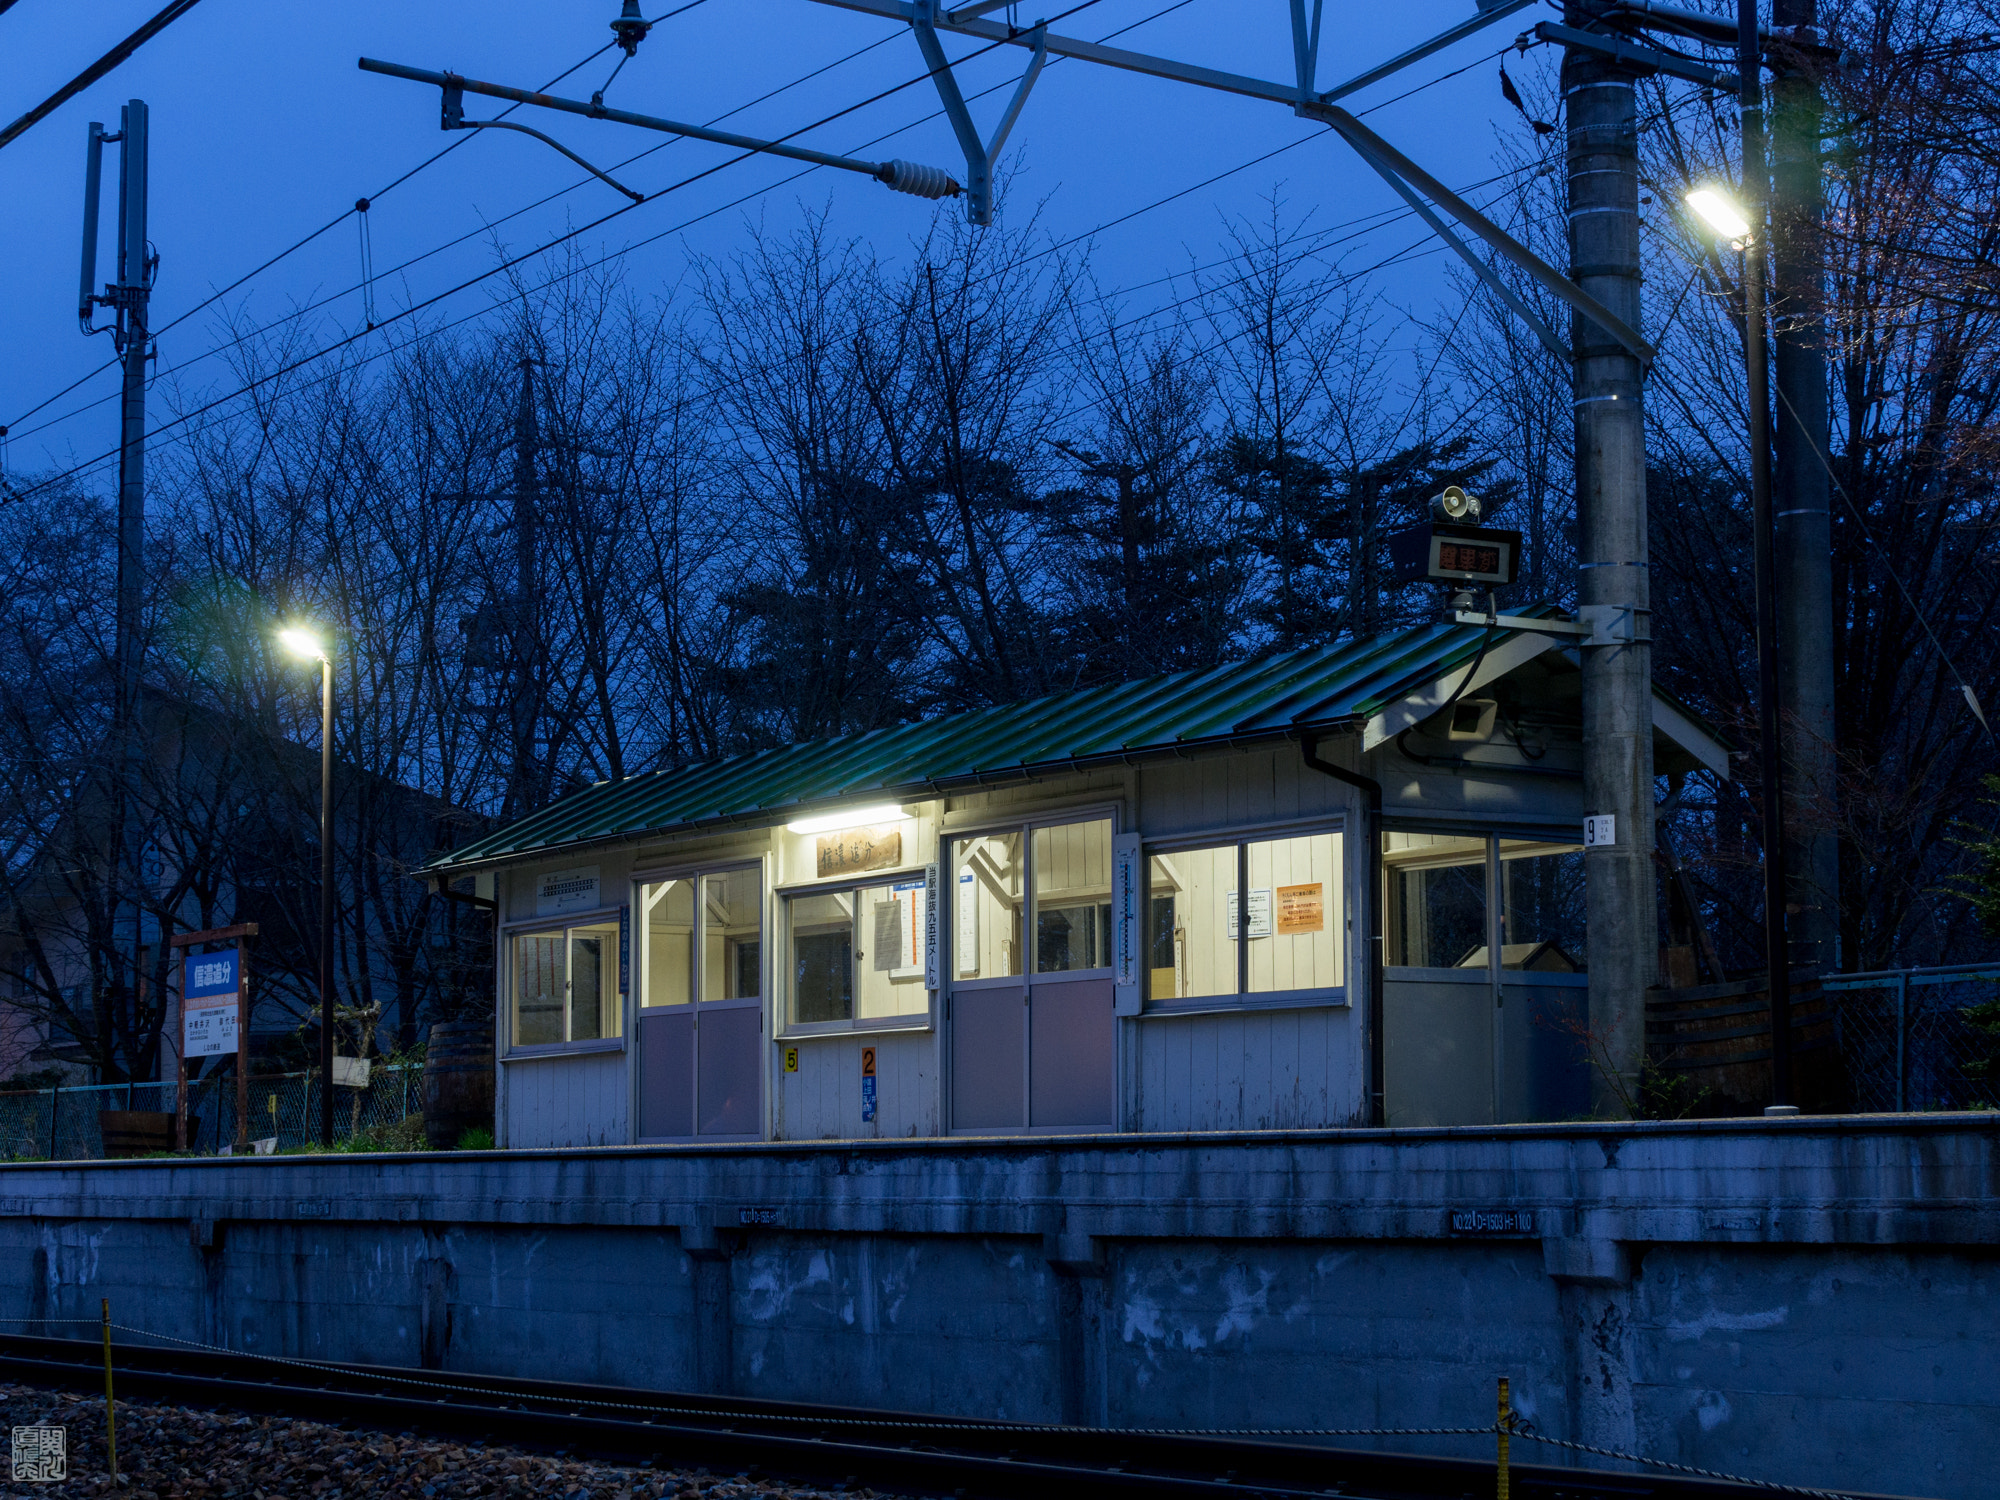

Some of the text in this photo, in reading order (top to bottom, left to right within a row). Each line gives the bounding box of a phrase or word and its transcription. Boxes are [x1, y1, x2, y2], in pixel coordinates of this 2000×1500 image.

[1588, 819, 1595, 844] 9
[928, 866, 937, 986] 当駅海抜九五五メートル
[621, 907, 629, 984] しなのおいわけ
[194, 961, 231, 988] 信濃追分
[788, 1052, 796, 1068] 5
[864, 1050, 874, 1074] 2
